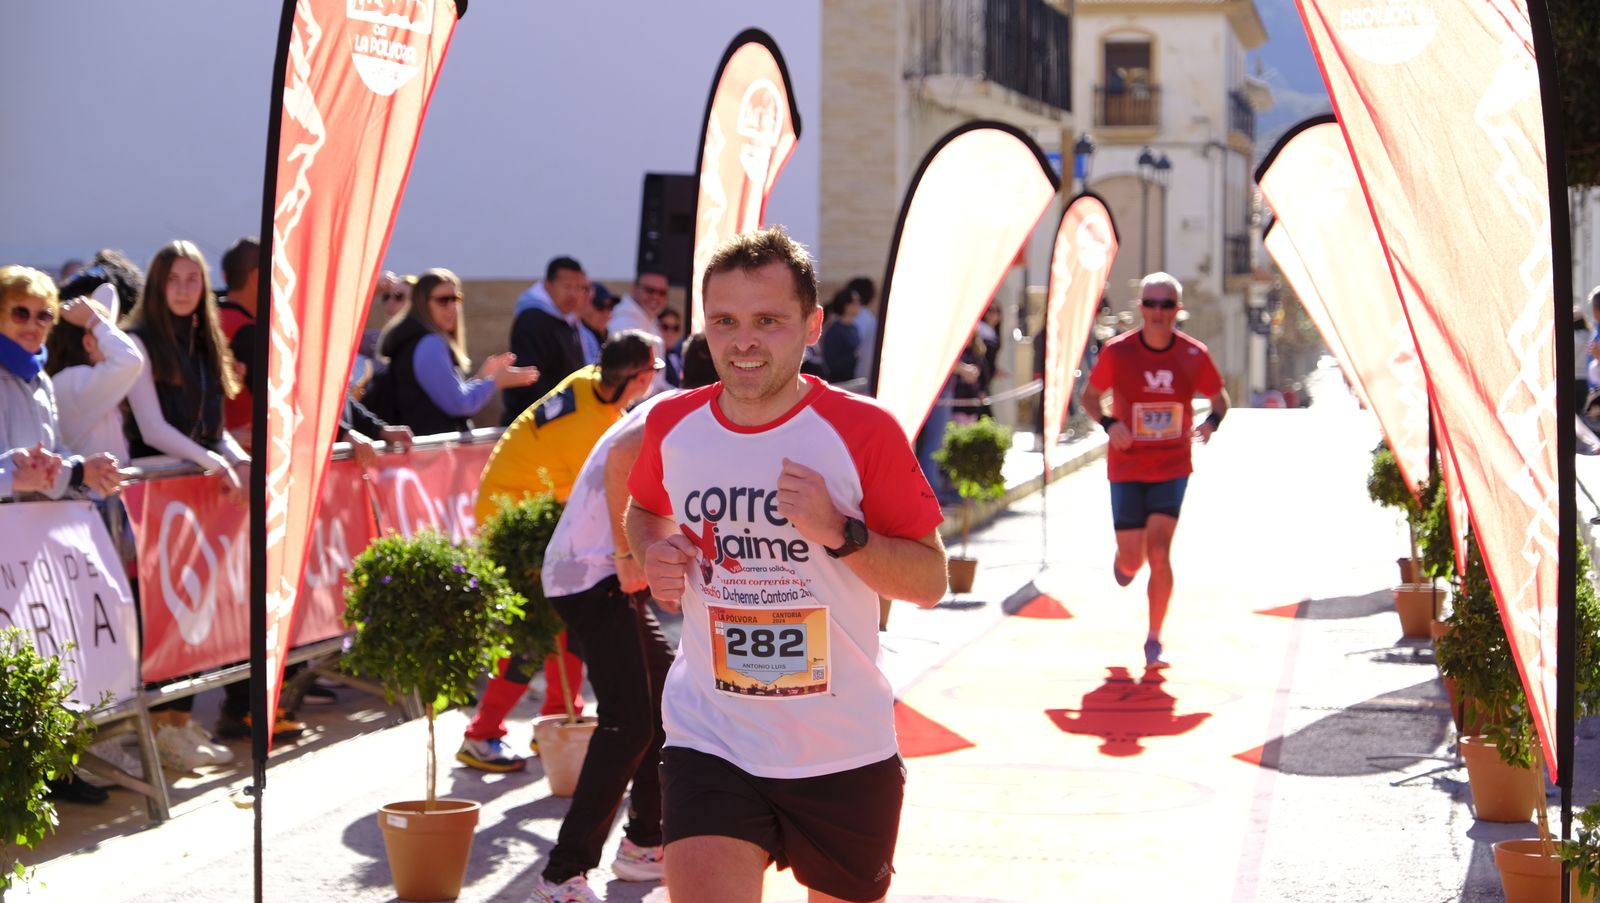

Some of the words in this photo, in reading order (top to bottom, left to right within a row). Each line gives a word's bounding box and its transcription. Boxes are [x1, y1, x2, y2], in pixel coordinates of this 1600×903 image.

[1144, 369, 1174, 389] VR
[714, 528, 810, 565] jaime
[64, 552, 99, 580] DE
[761, 588, 798, 605] Cantoria
[772, 611, 802, 619] CANTORIA
[726, 627, 804, 658] 282
